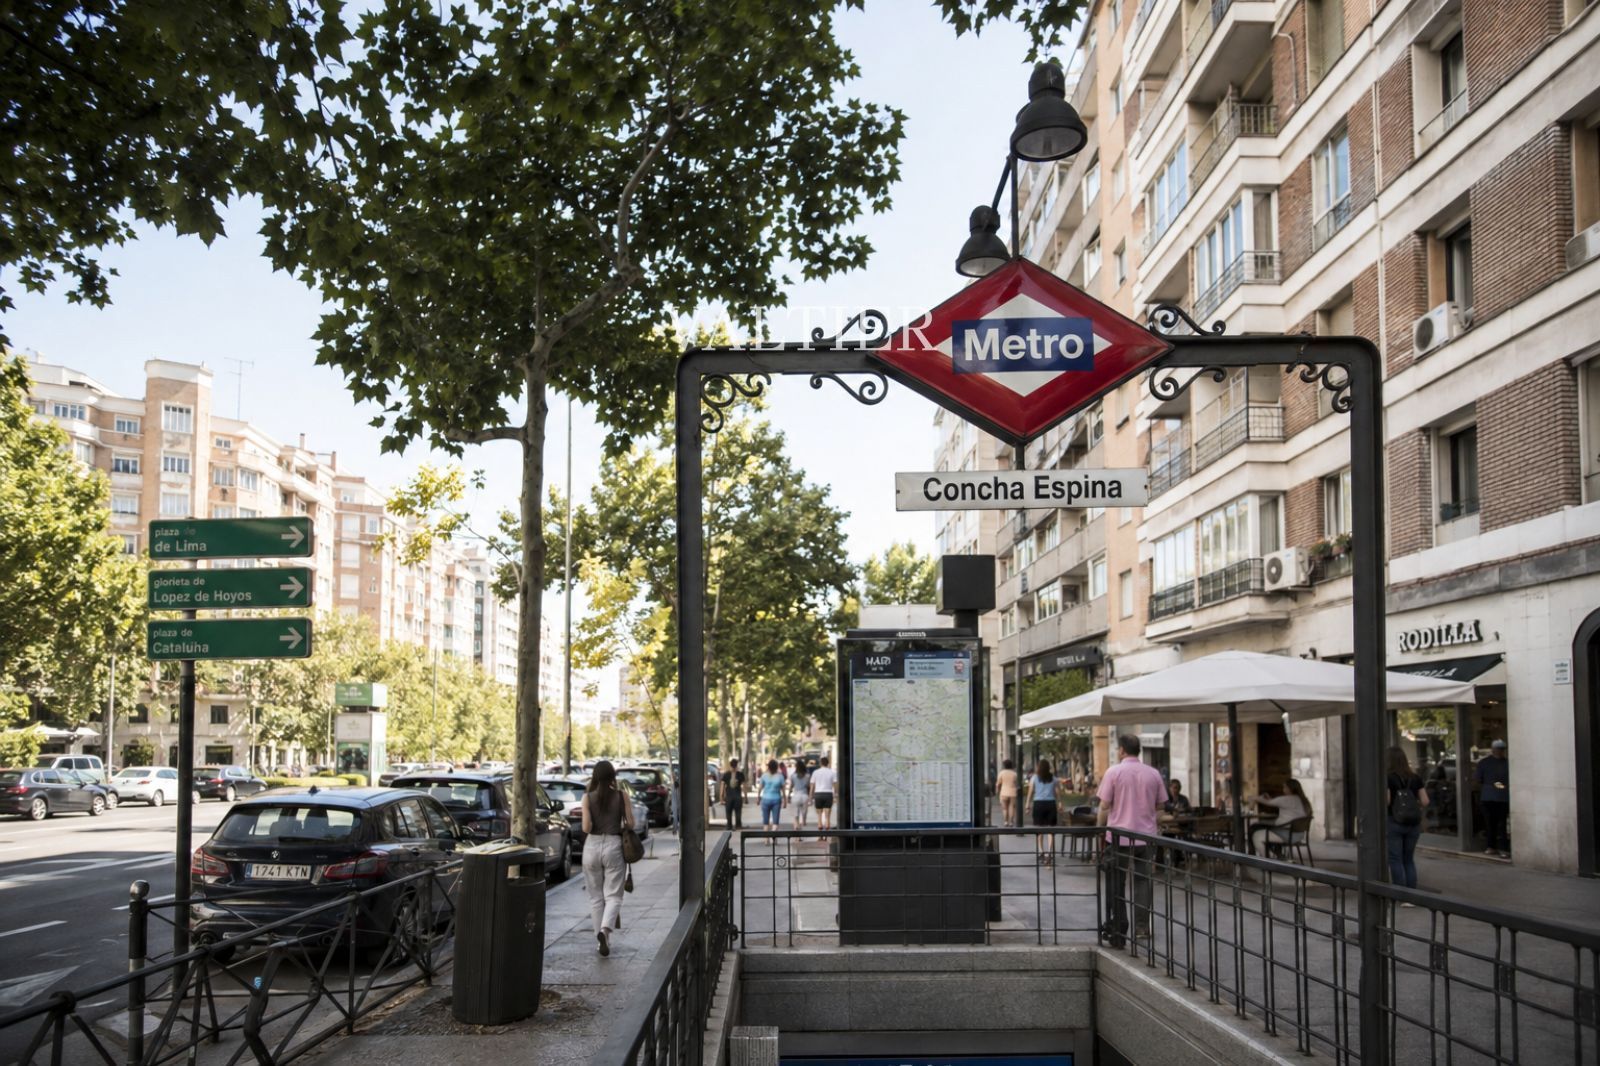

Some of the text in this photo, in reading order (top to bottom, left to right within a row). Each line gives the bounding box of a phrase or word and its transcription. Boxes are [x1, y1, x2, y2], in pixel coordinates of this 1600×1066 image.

[964, 328, 1084, 361] Metro
[923, 474, 1122, 505] Concha Espina
[154, 540, 207, 553] de Lima
[153, 577, 206, 589] glorieta de
[153, 590, 252, 605] Lopez de Hoyos
[153, 628, 193, 639] plaza de
[1398, 620, 1481, 653] RODILLA
[255, 865, 308, 877] 1741 KTN
